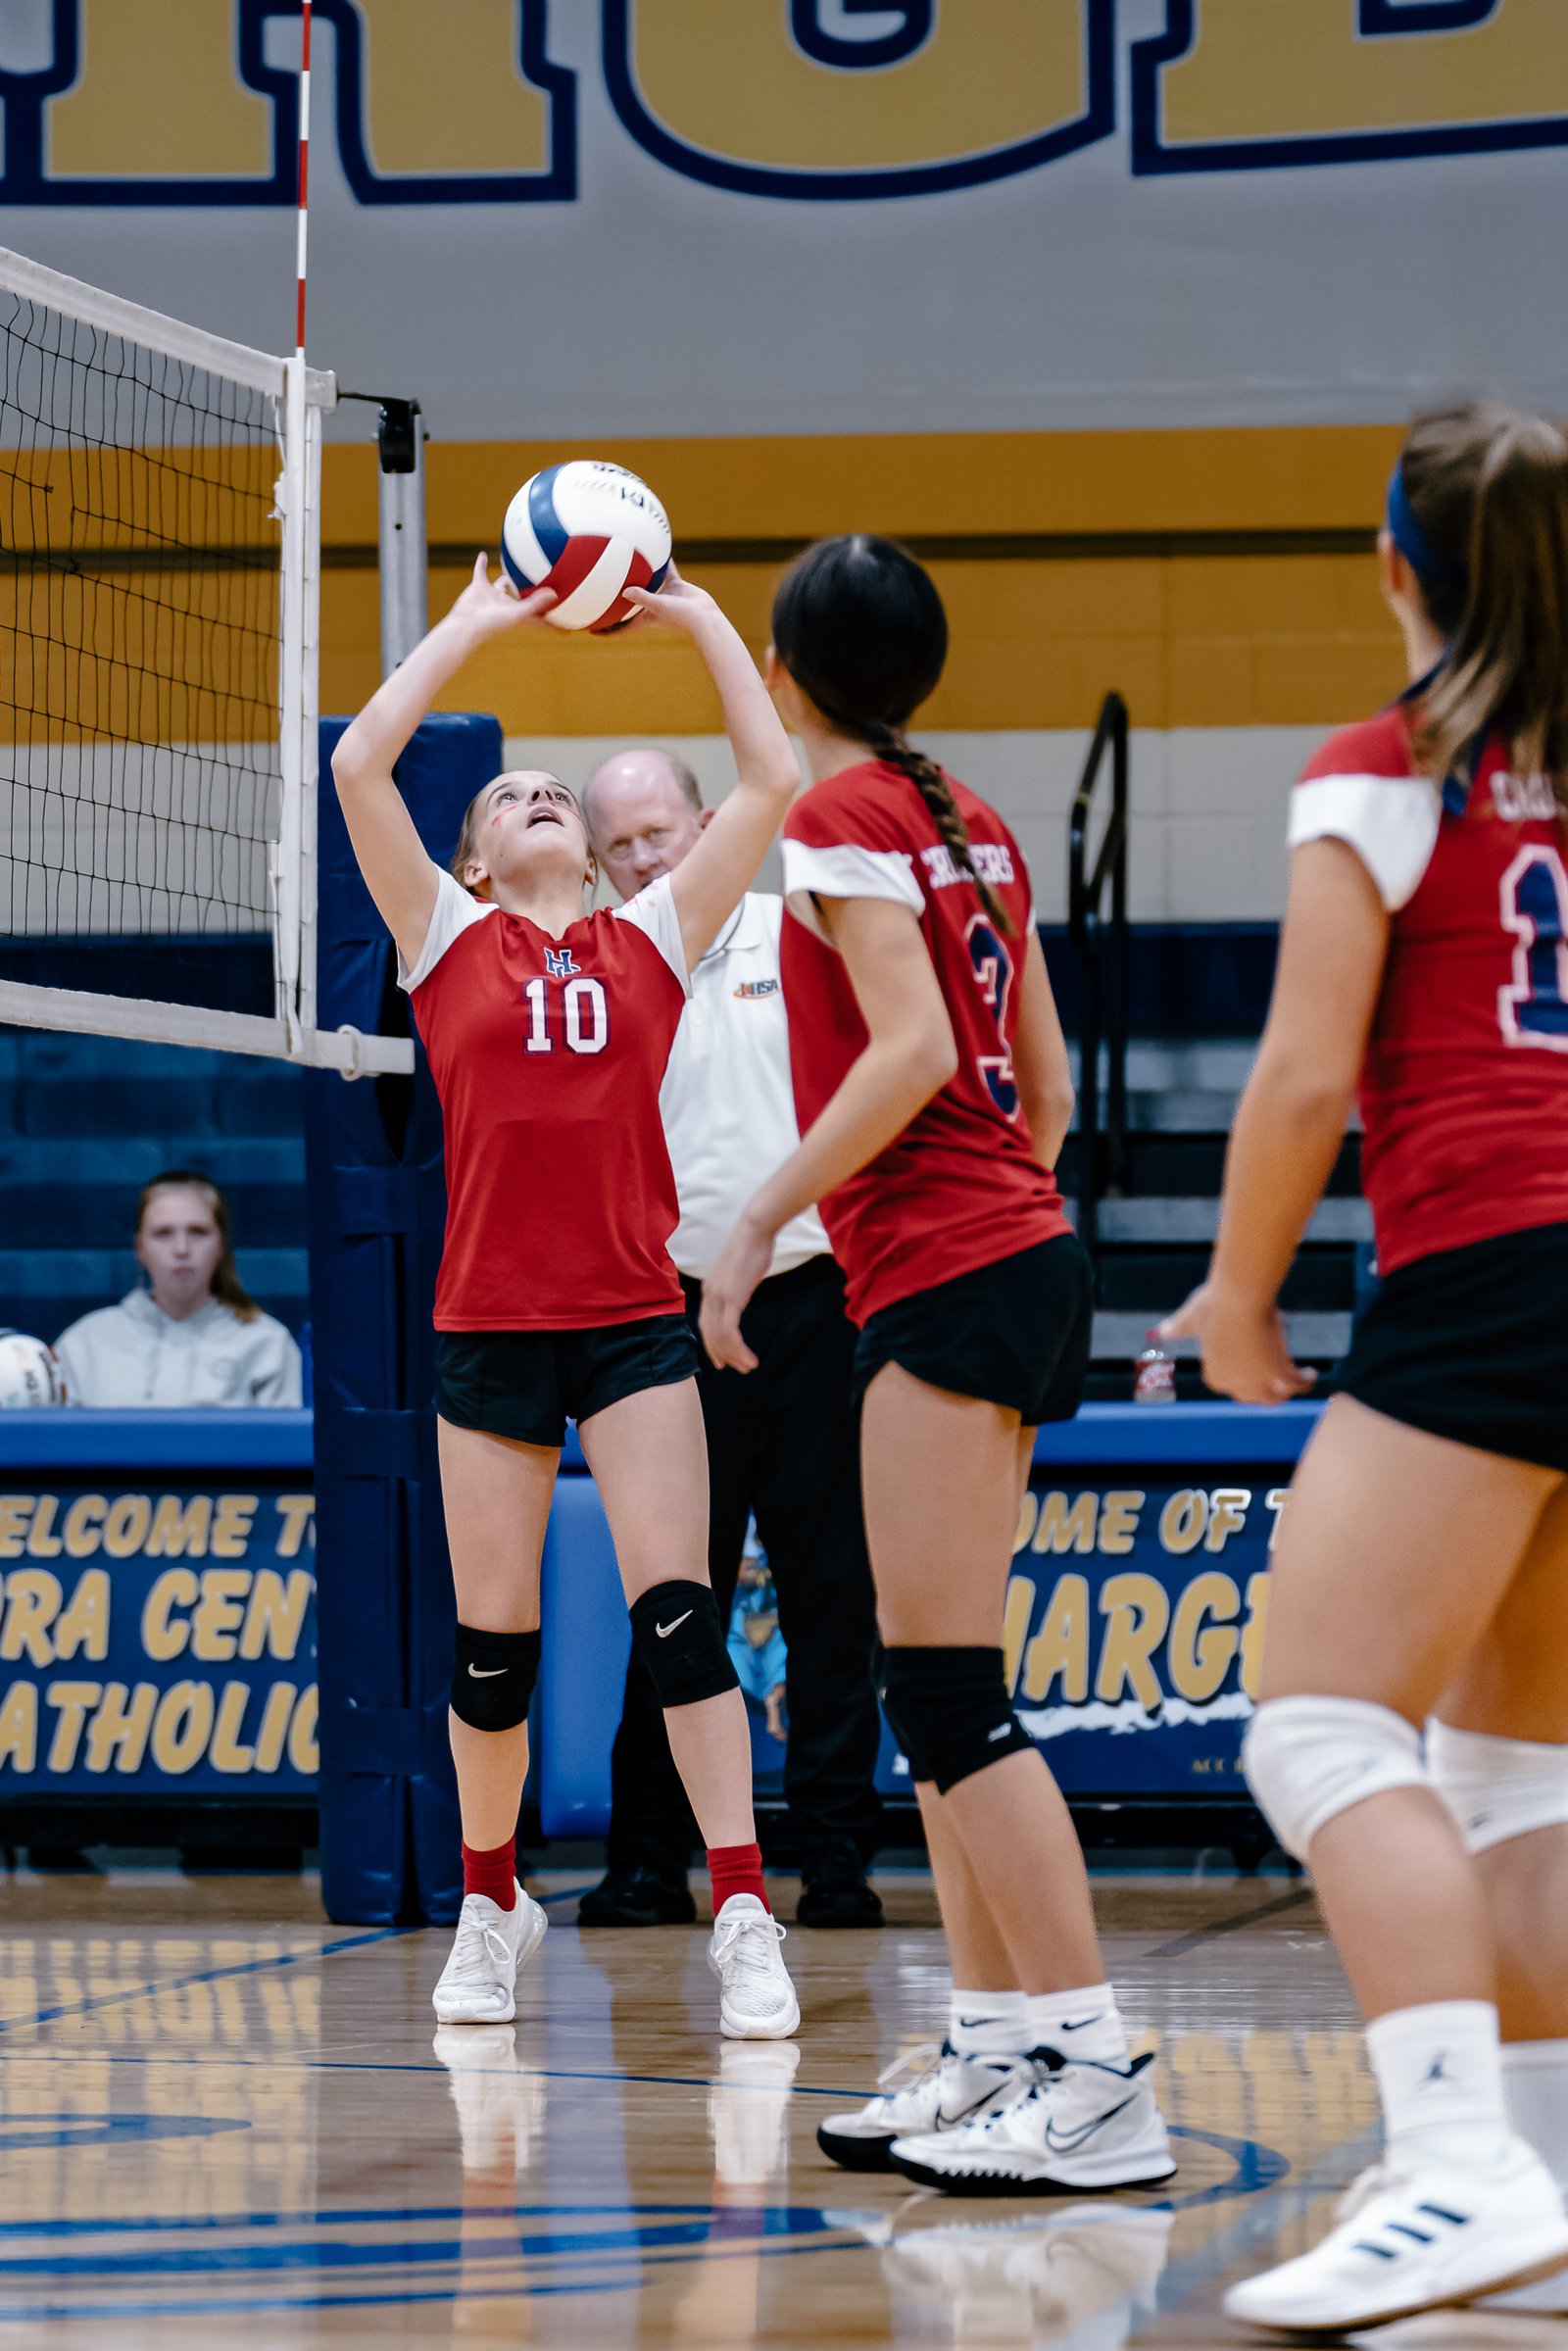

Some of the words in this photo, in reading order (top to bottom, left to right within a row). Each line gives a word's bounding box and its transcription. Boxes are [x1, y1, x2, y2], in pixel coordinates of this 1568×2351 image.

[522, 976, 611, 1055] 10
[274, 1494, 318, 1558] T
[1158, 1488, 1251, 1553] OF
[0, 1568, 111, 1669] RA
[141, 1567, 318, 1662] CEN
